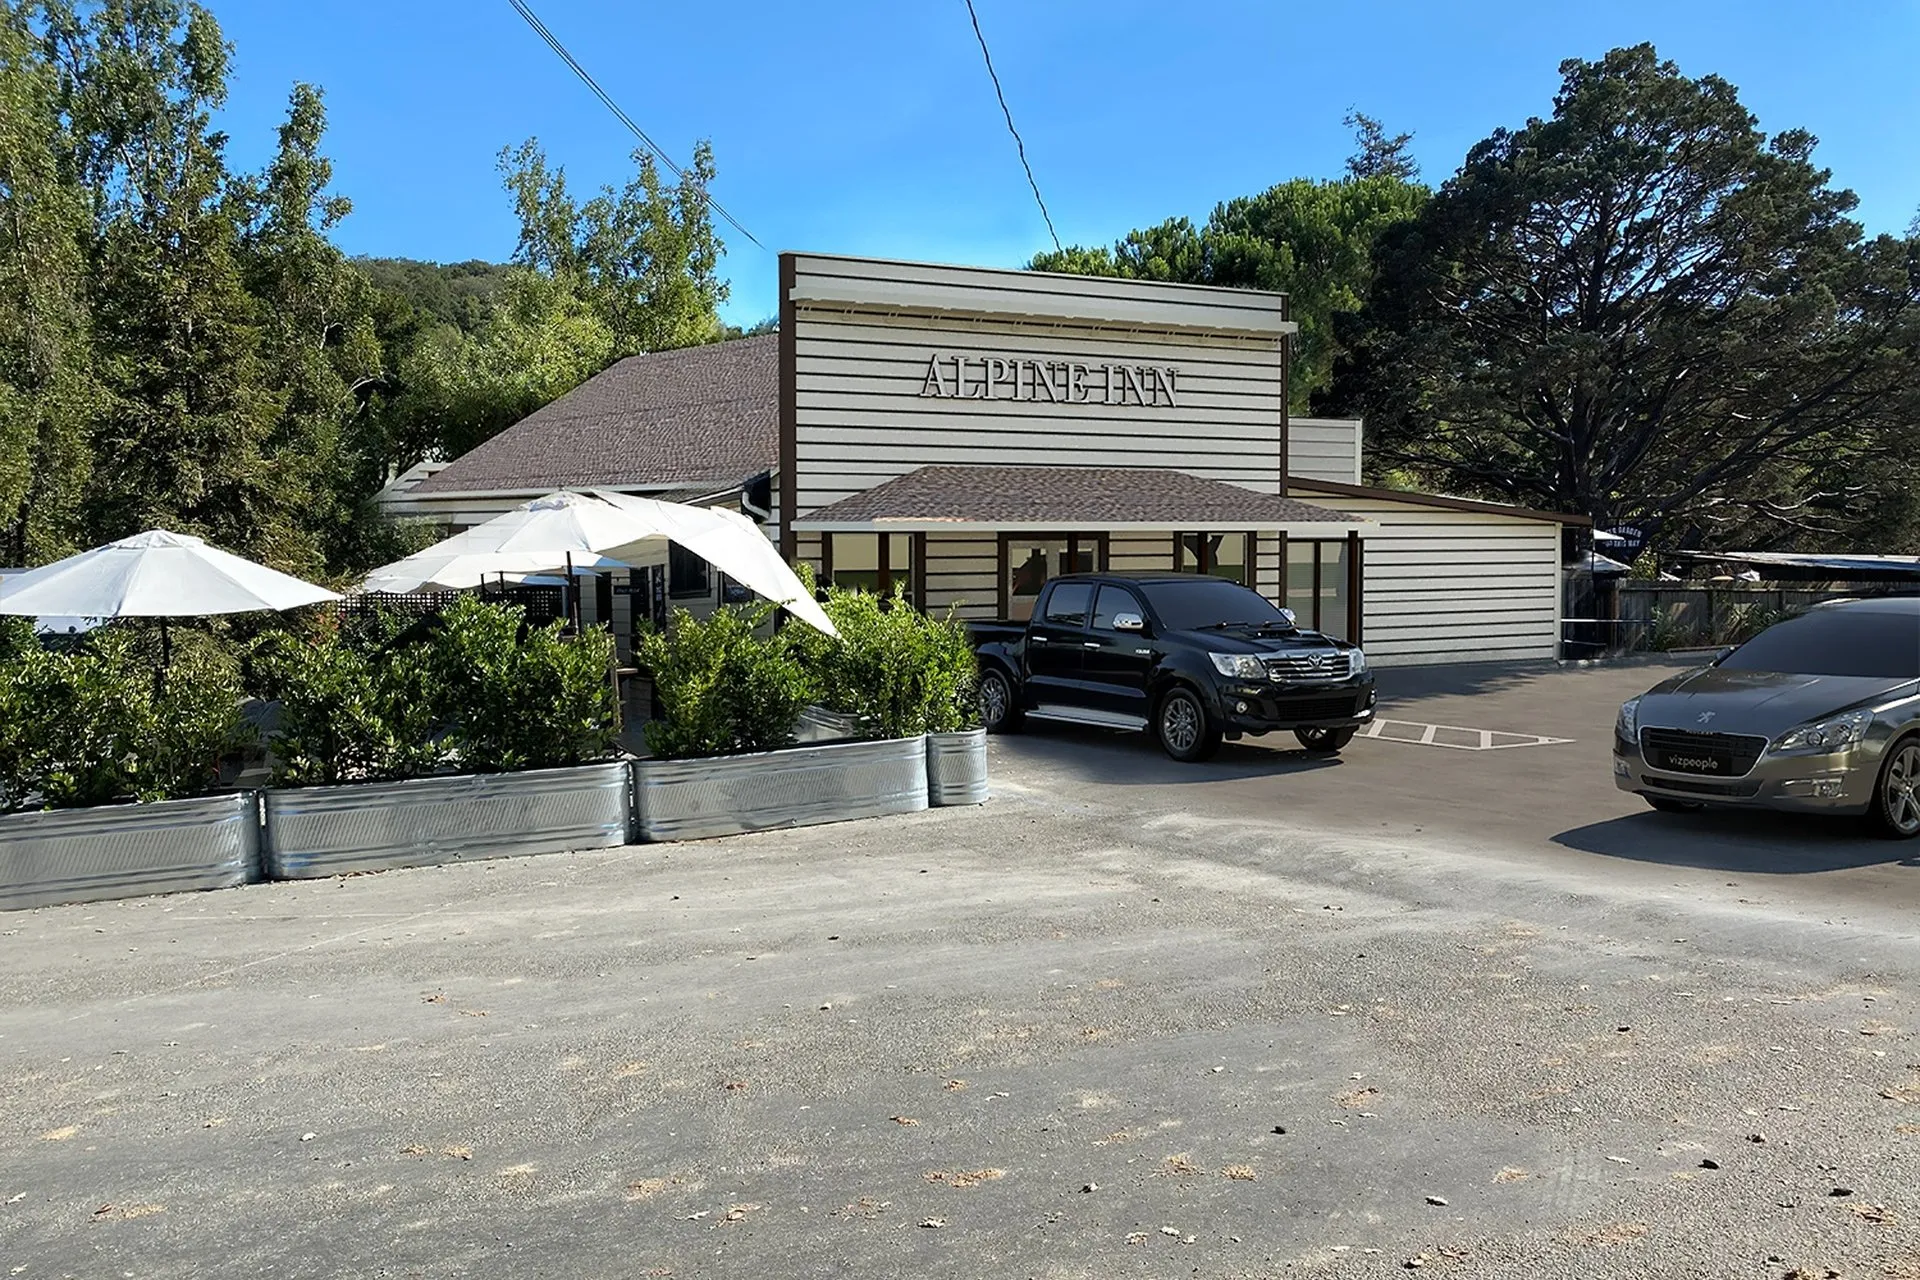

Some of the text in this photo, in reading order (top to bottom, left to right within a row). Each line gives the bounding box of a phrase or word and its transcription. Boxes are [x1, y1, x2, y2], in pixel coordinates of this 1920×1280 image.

[919, 353, 1179, 408] ALPINE INN
[1669, 754, 1719, 771] vizpeople
